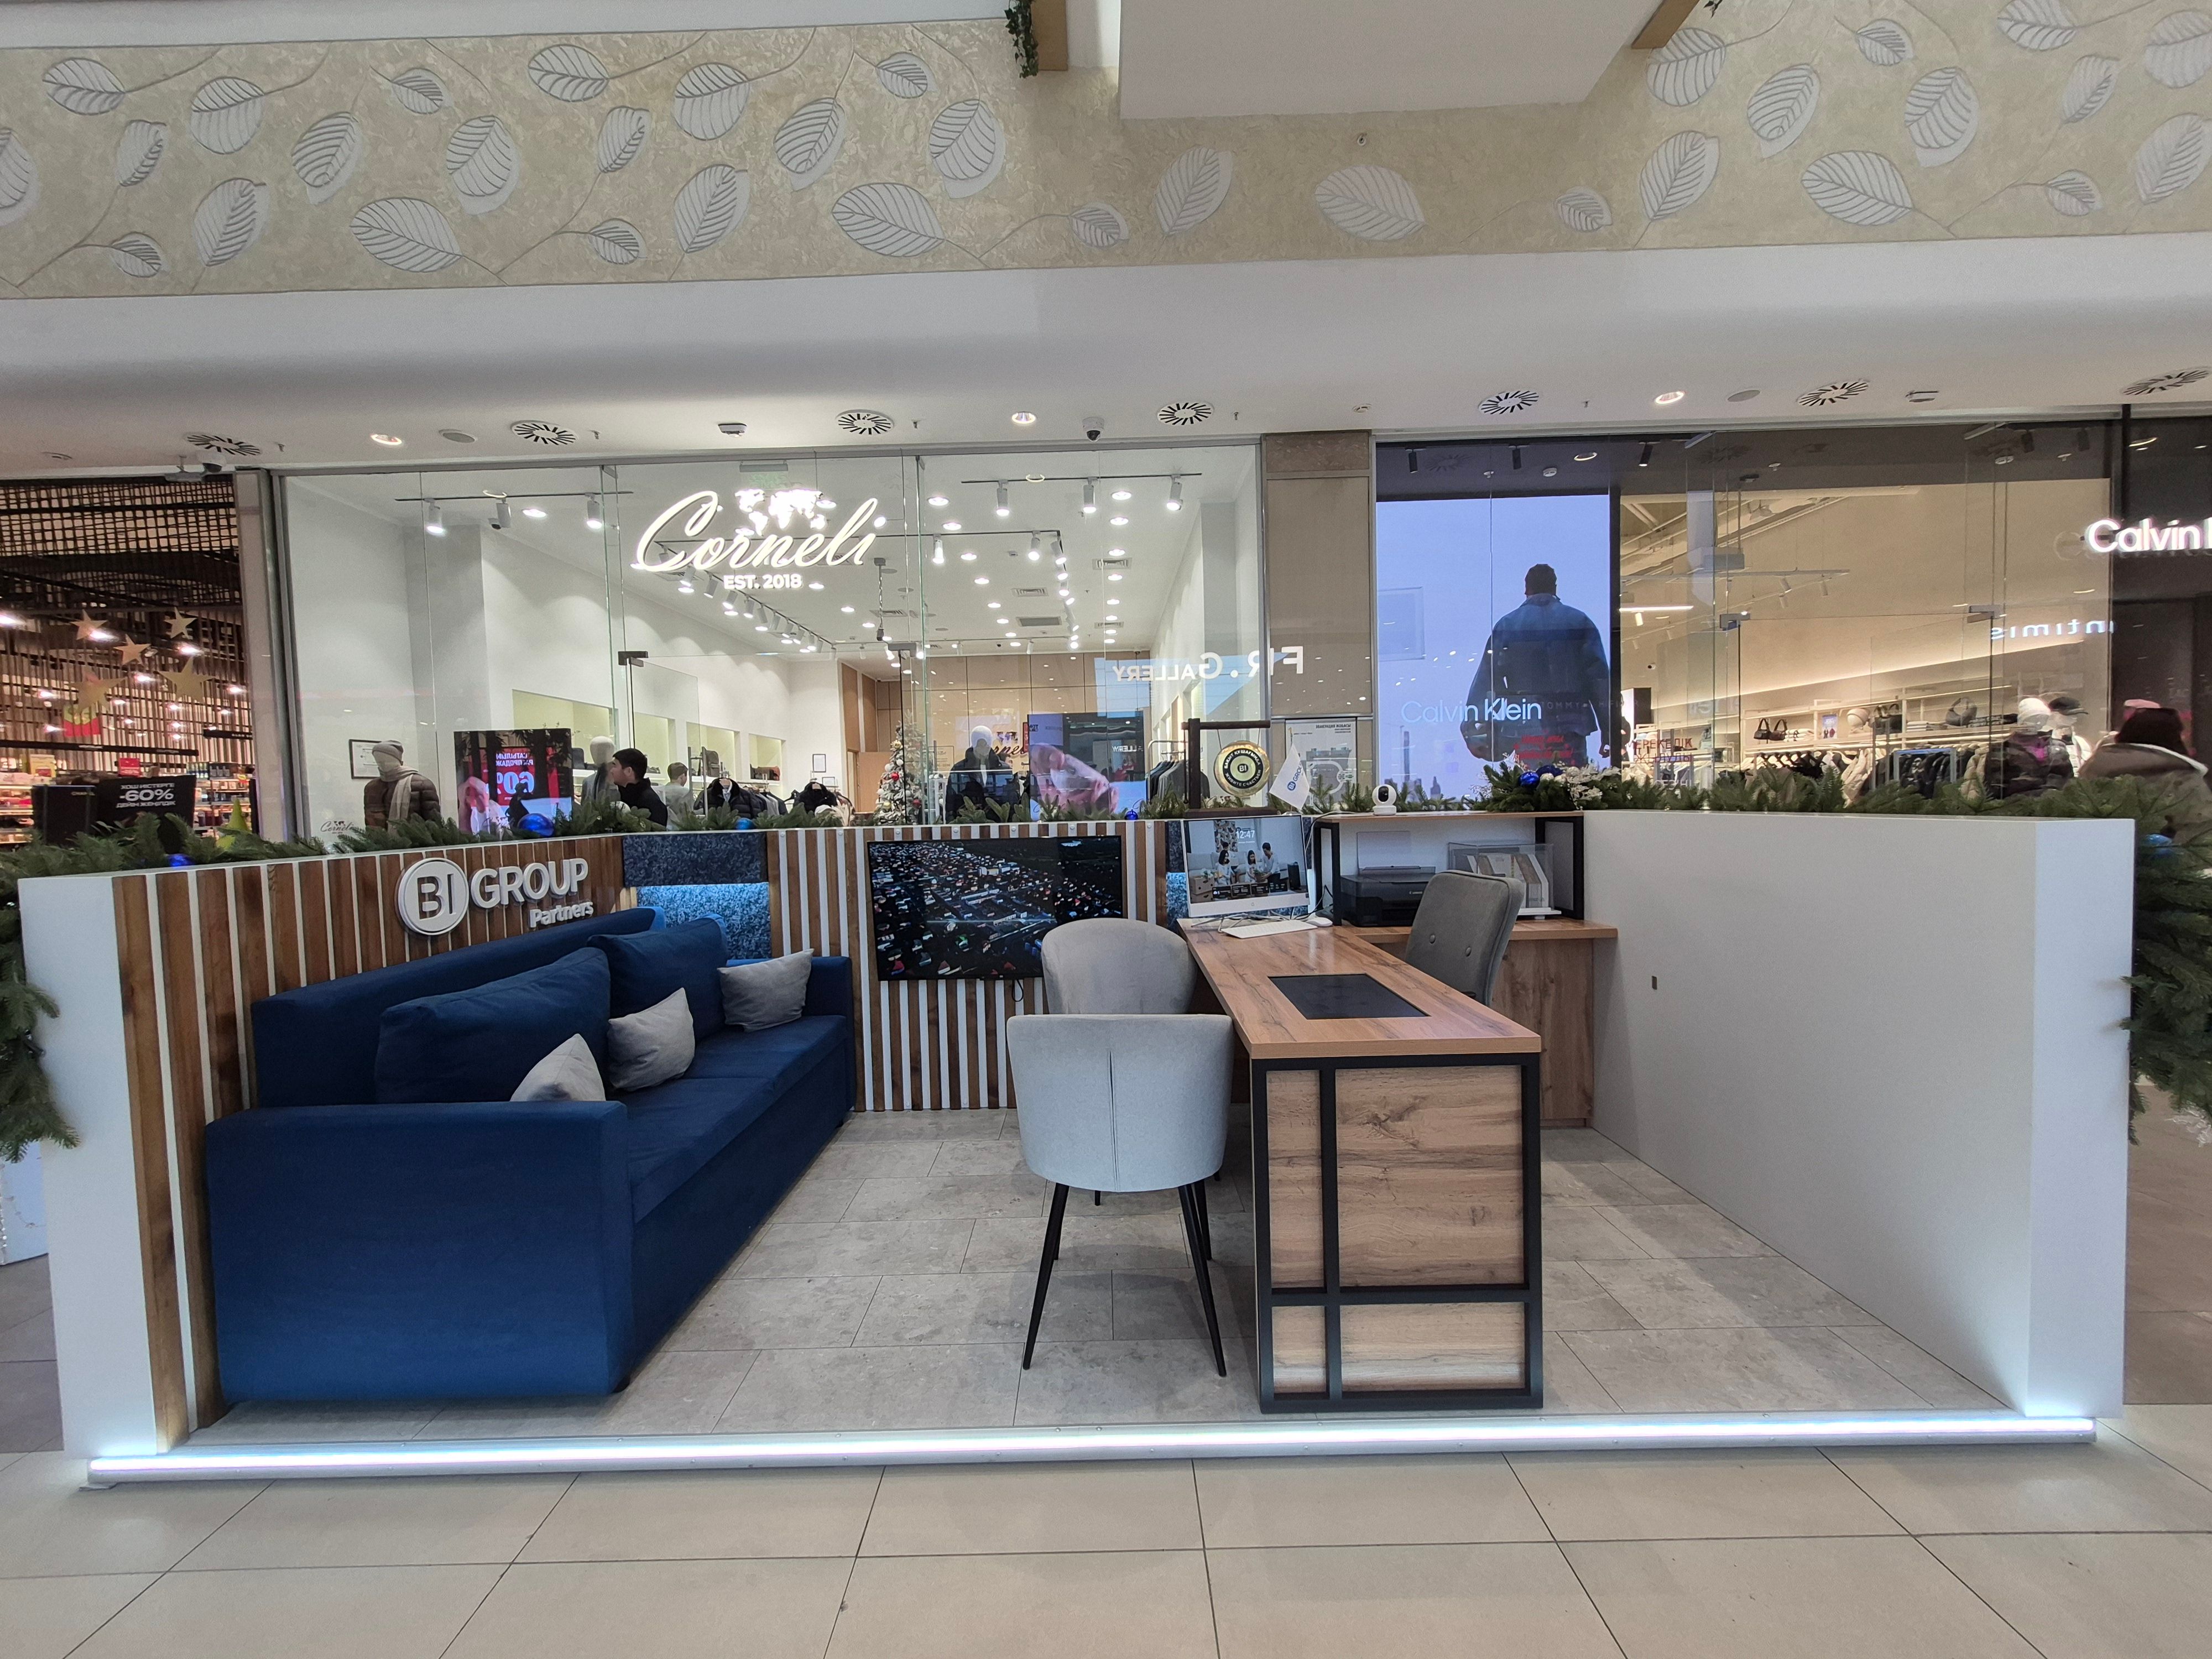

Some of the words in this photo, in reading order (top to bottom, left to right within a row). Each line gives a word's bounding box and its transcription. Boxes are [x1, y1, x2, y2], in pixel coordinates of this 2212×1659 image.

[637, 491, 878, 571] Corneli
[2086, 517, 2201, 552] Calvin
[723, 575, 760, 589] EST.
[763, 573, 802, 589] 2018
[1401, 700, 1478, 722] Calvin
[1484, 697, 1542, 721] Klein
[119, 789, 174, 801] -60%
[1235, 830, 1255, 839] 12:47
[471, 858, 588, 909] GROUP
[528, 901, 594, 928] Partners
